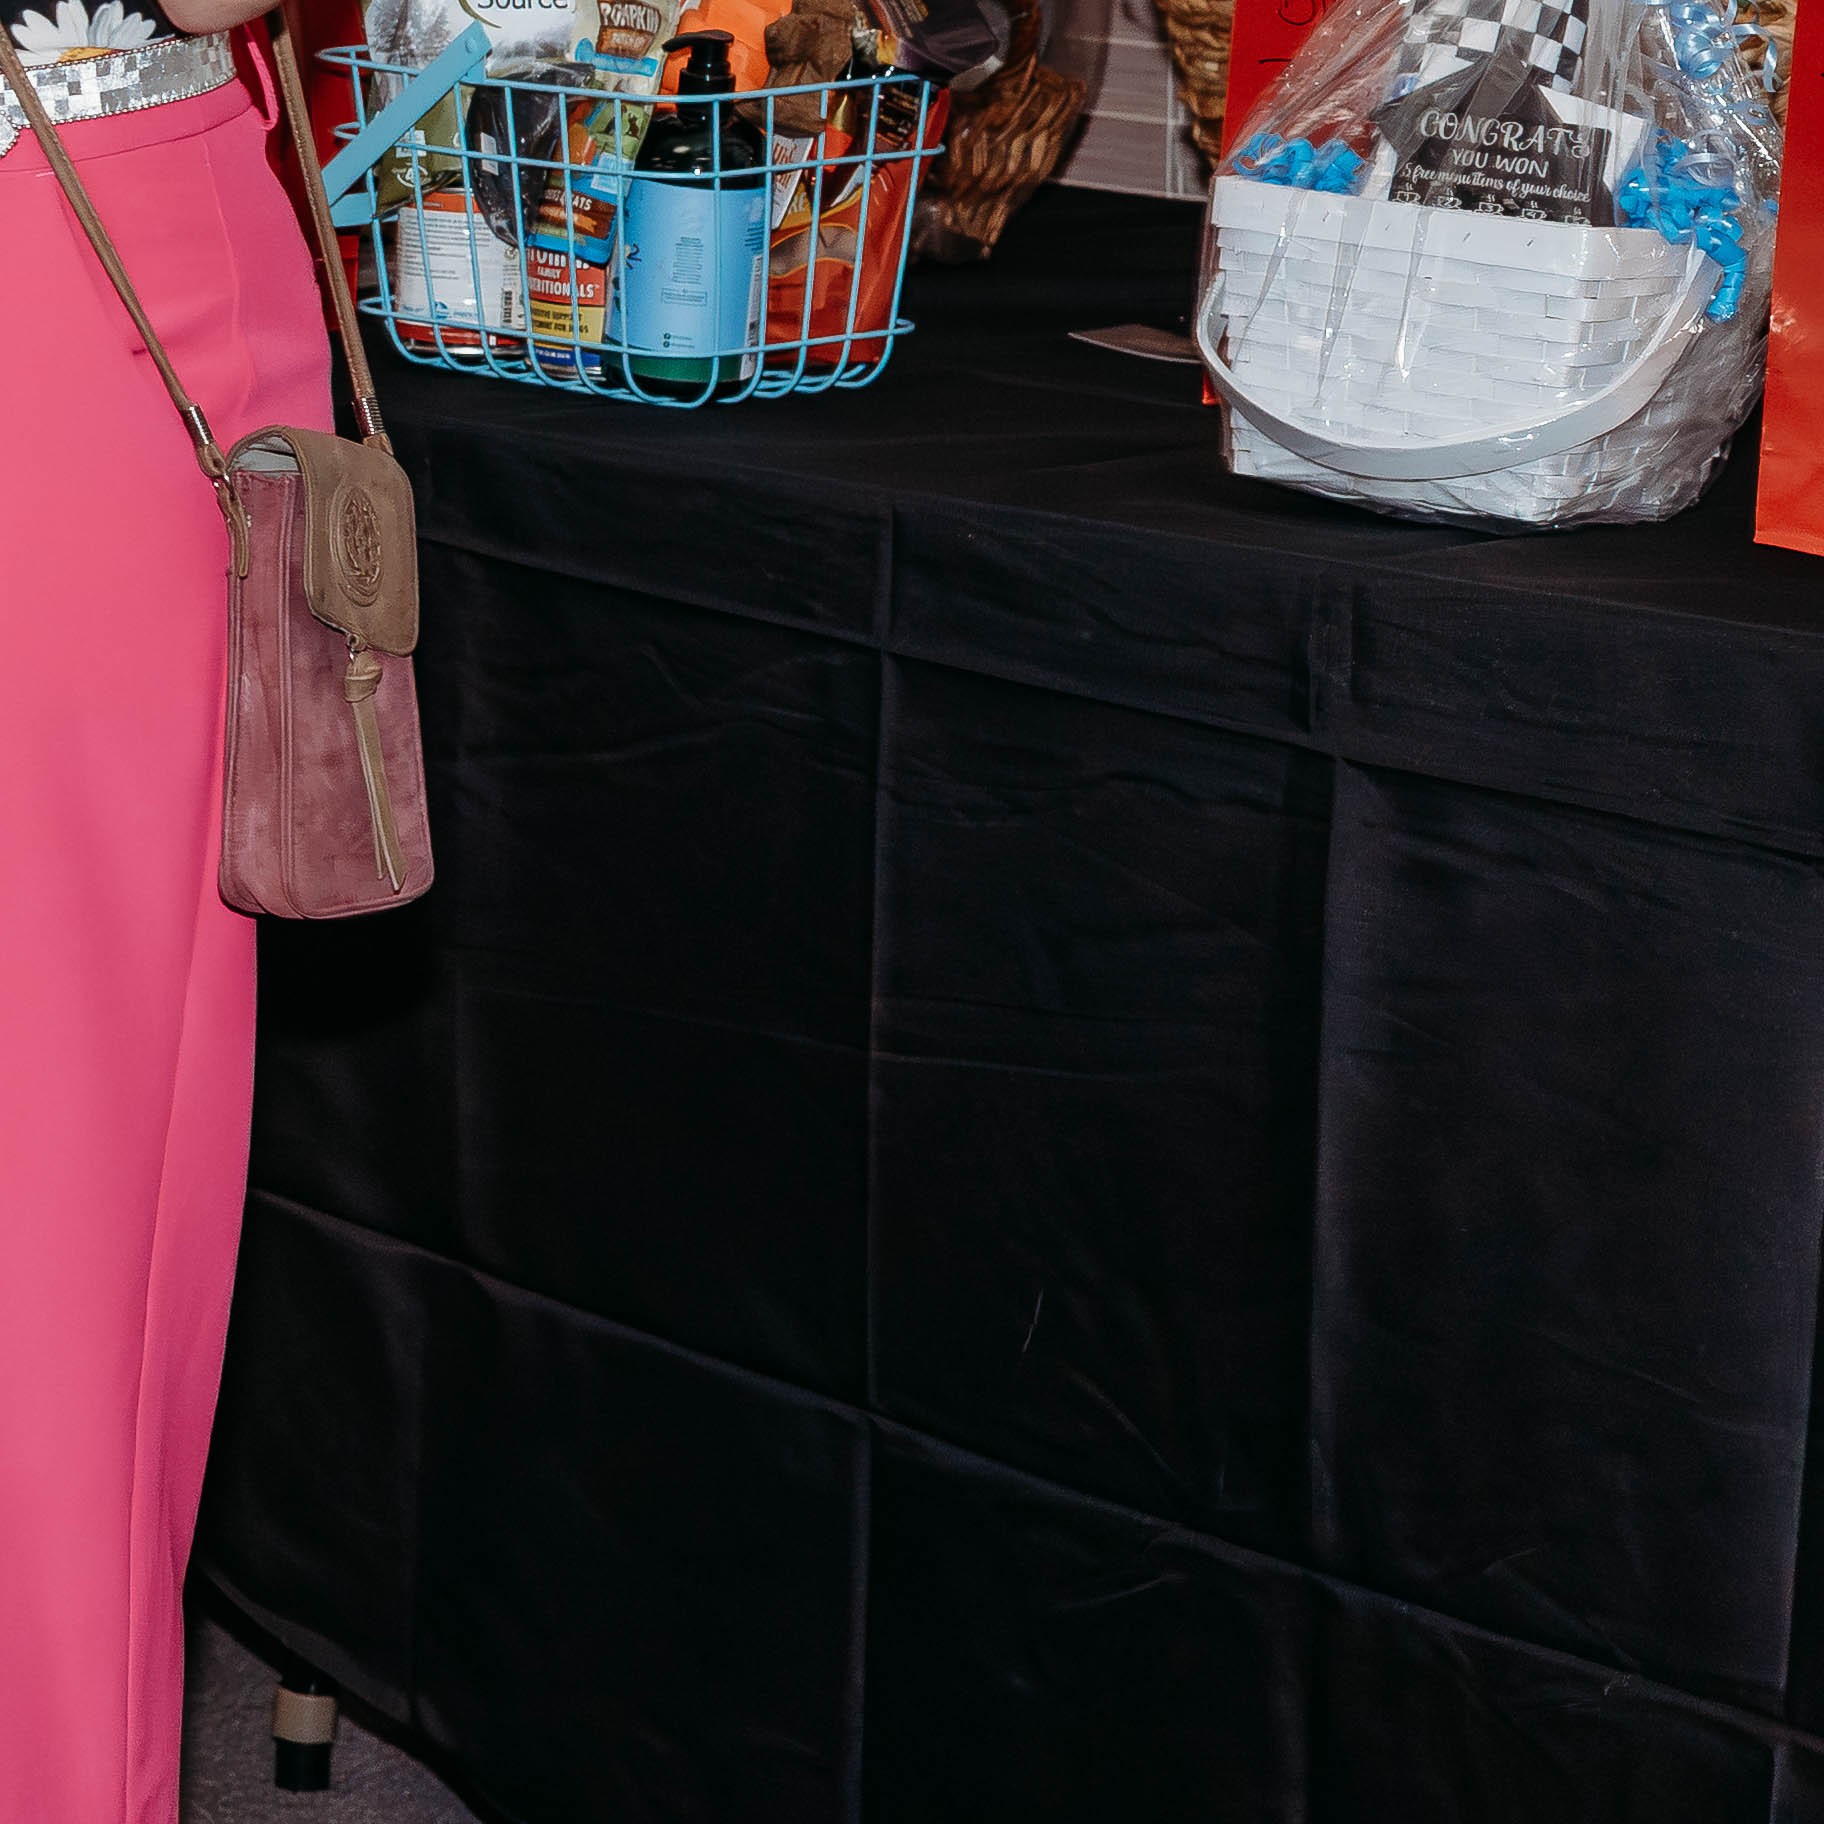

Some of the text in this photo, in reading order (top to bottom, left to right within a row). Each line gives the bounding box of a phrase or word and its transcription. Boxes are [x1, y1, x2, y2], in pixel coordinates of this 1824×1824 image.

[1452, 147, 1549, 178] YOU WON
[1412, 164, 1439, 183] free
[1505, 179, 1521, 197] of
[1520, 182, 1552, 200] your
[1551, 184, 1592, 203] choice
